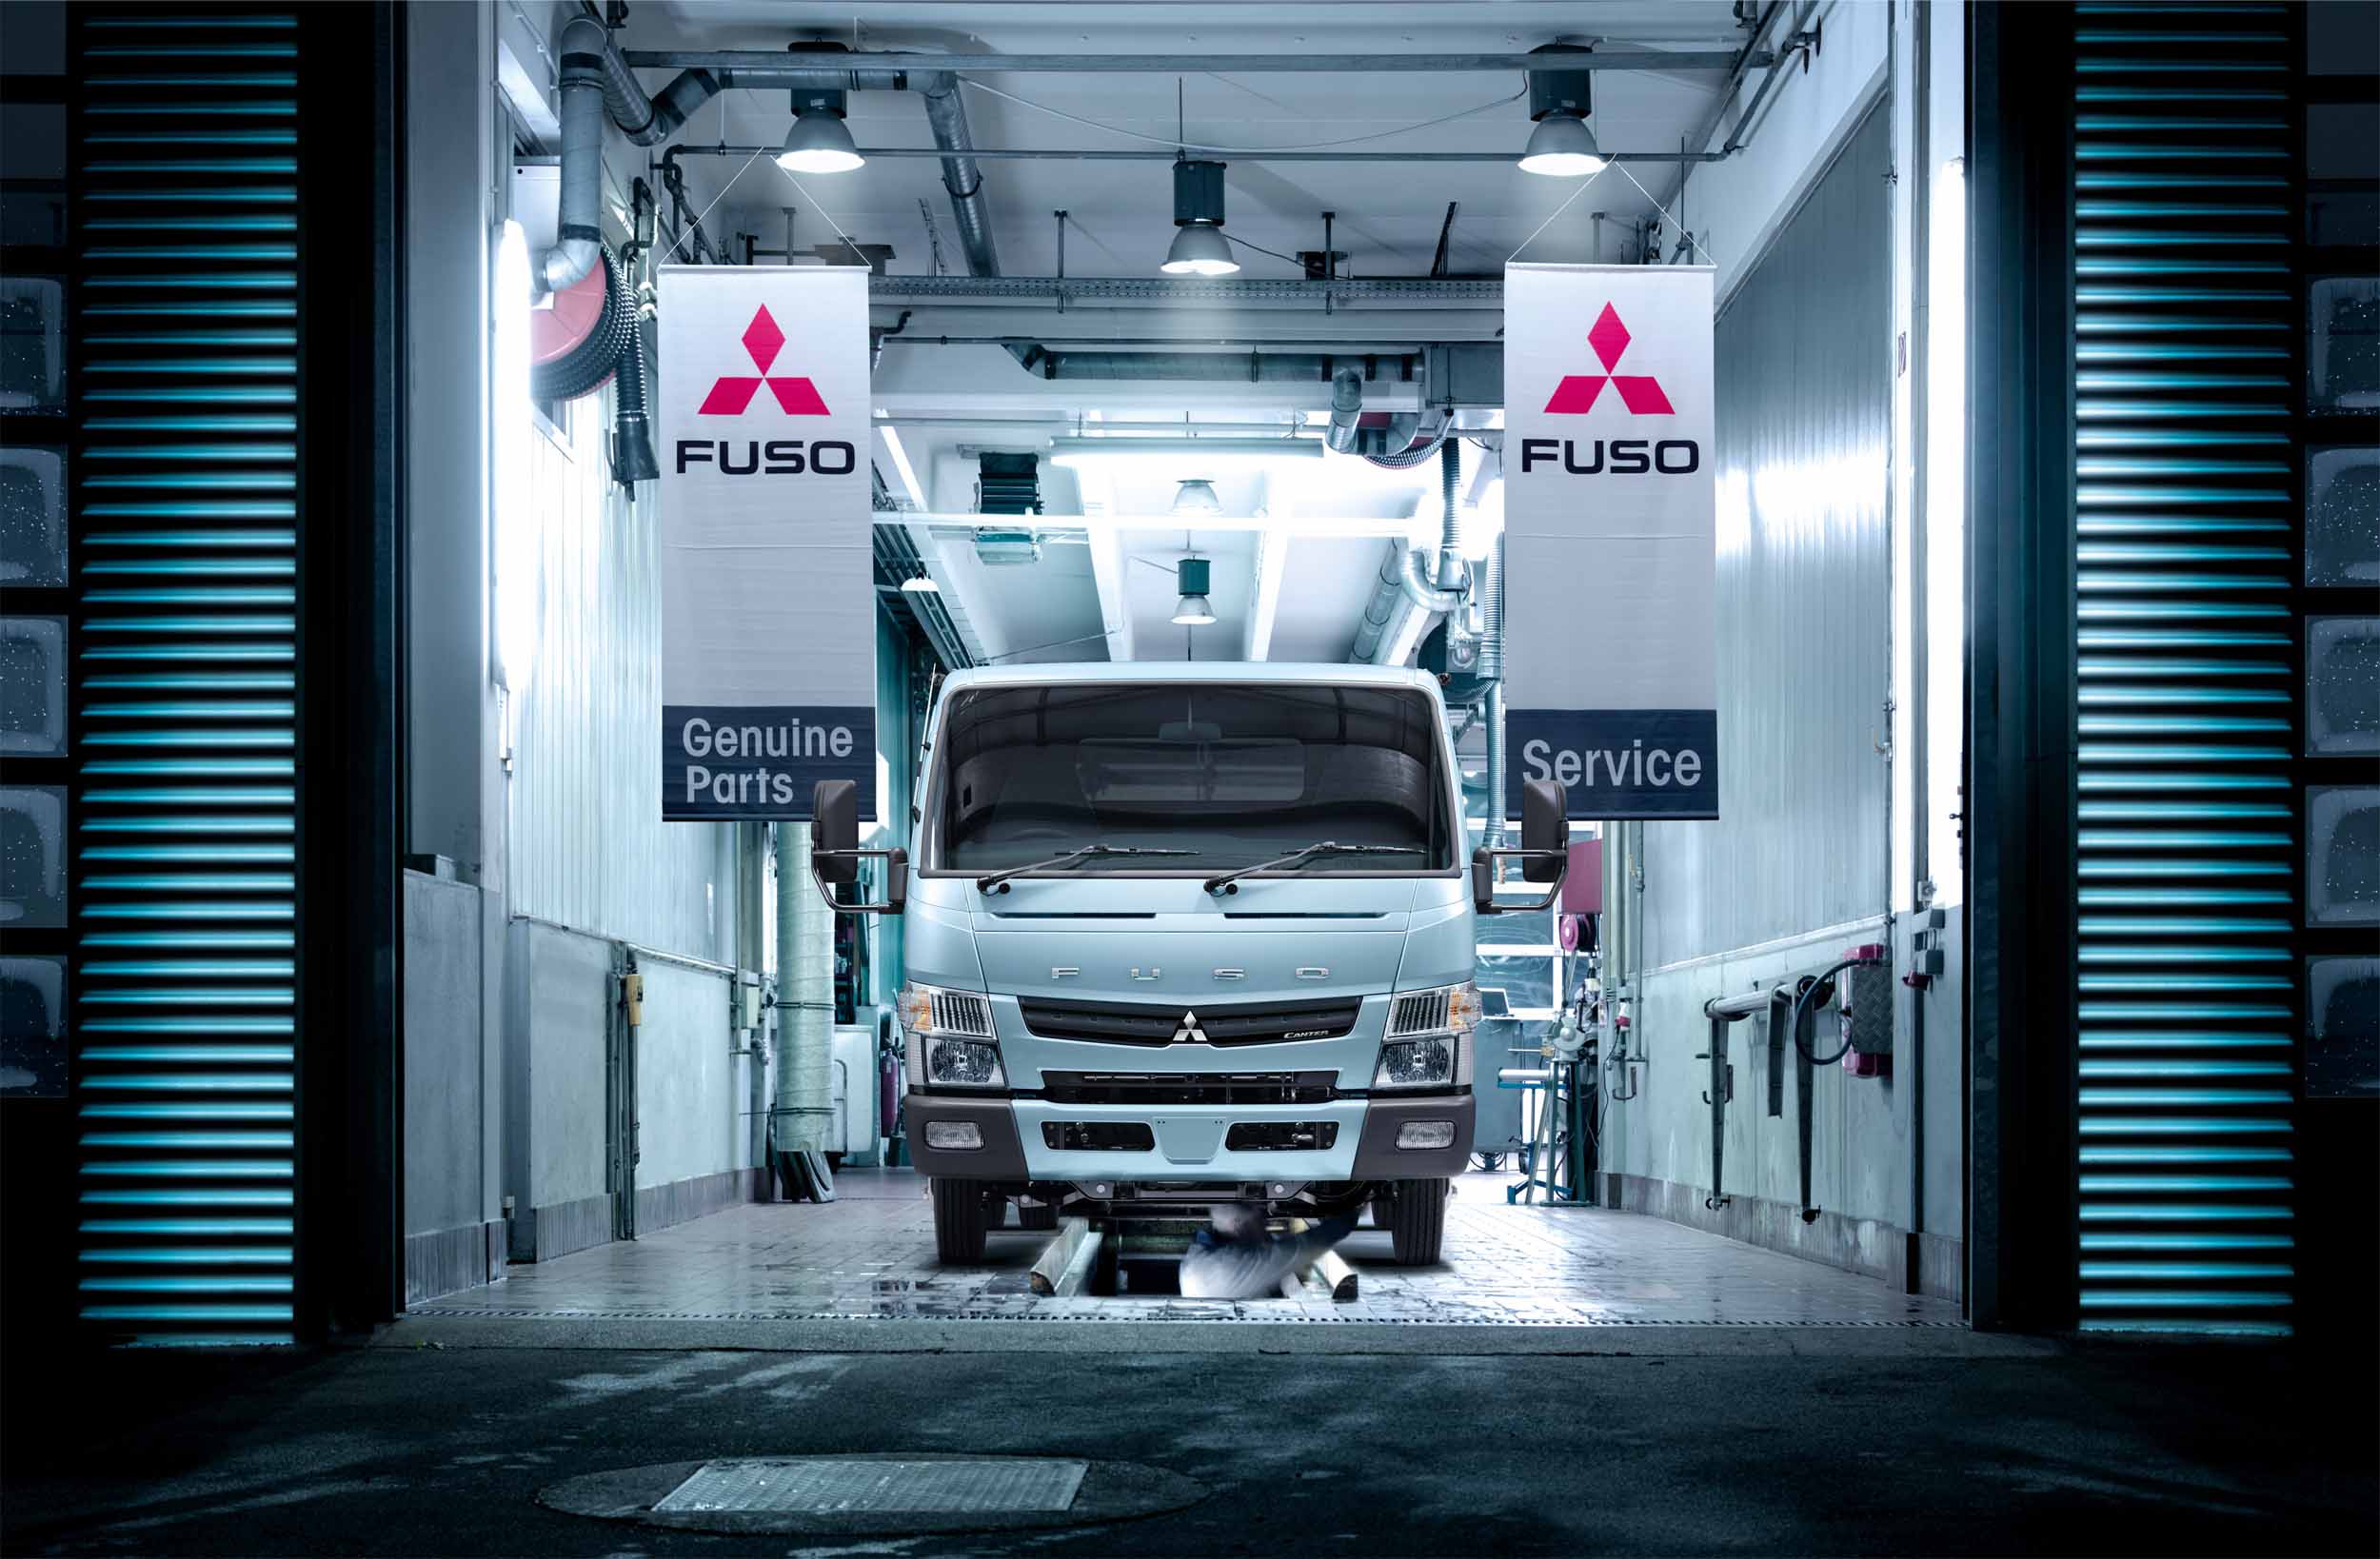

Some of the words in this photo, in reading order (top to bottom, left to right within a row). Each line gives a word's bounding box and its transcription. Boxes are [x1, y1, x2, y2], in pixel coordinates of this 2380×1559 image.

[676, 440, 856, 475] FUSO
[1521, 438, 1699, 474] FUSO
[682, 717, 853, 758] Genuine
[1522, 739, 1702, 786] Service
[685, 764, 794, 804] Parts
[1051, 966, 1331, 980] FUSO
